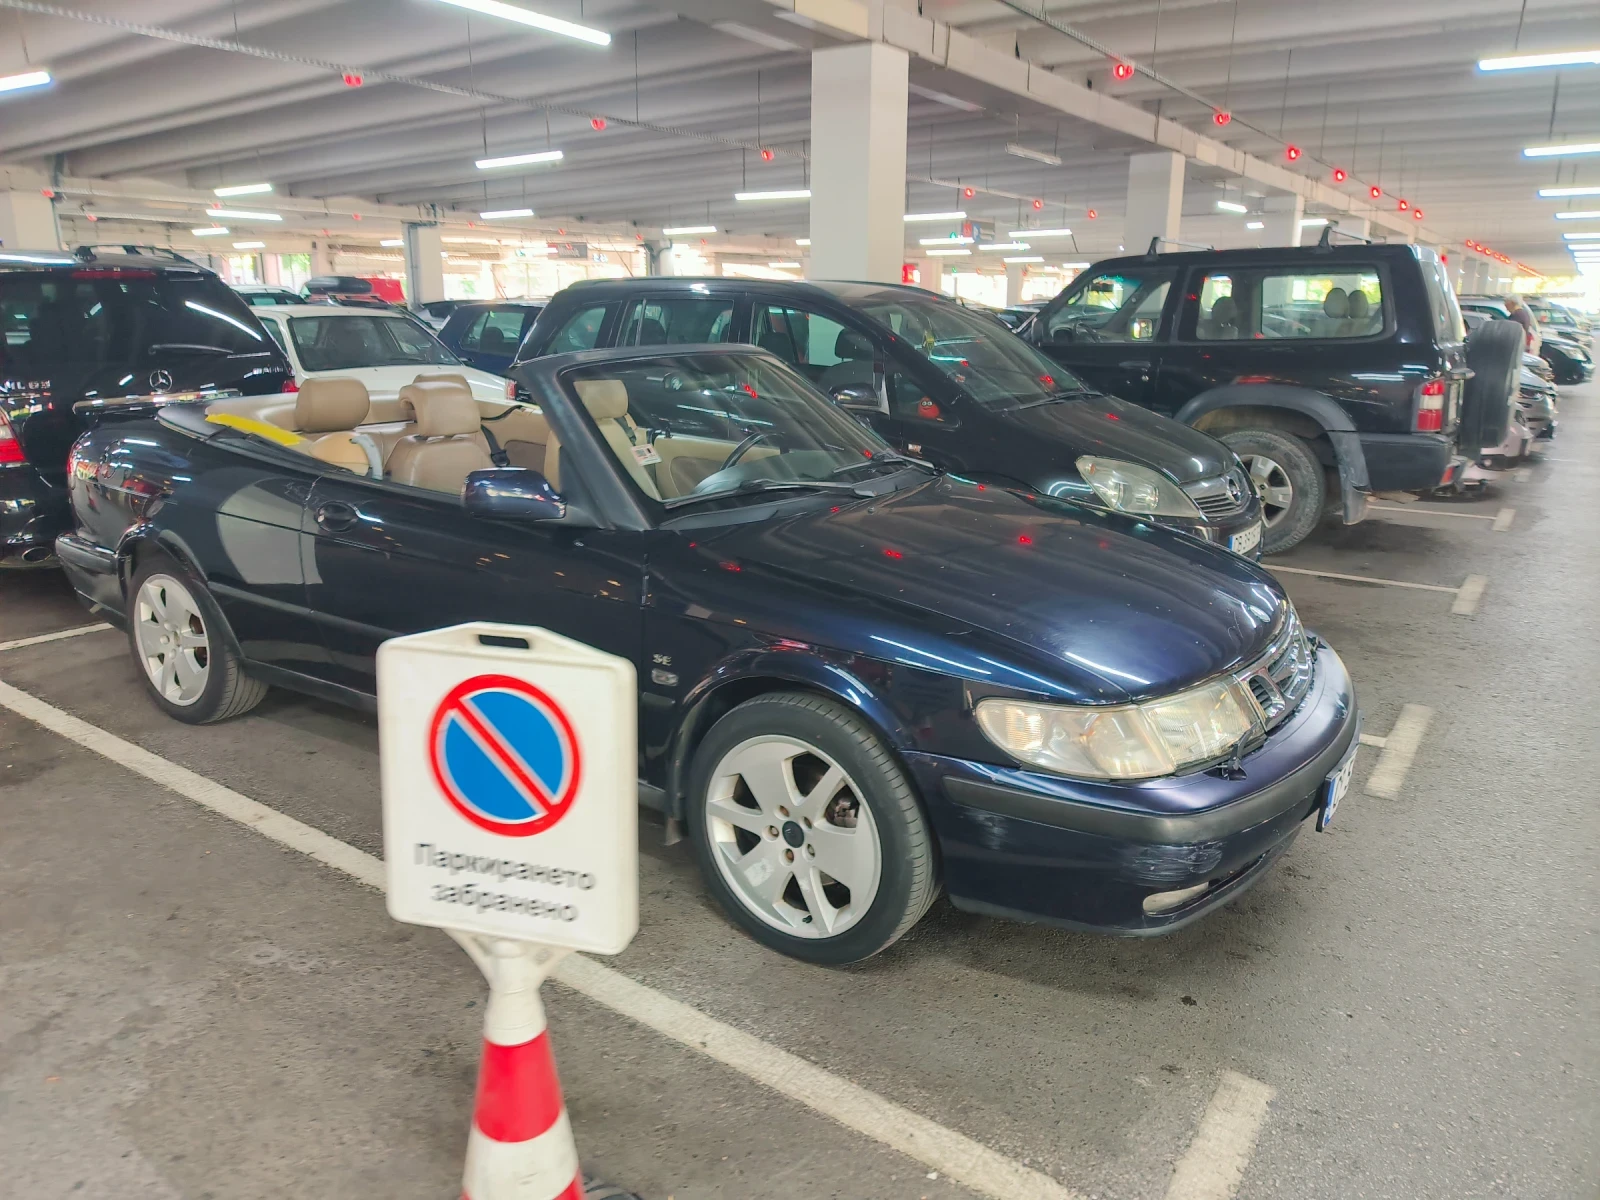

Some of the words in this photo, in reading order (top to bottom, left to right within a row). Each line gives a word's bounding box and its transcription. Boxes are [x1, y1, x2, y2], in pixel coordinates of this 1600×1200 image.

[652, 653, 672, 666] SE
[414, 843, 596, 891] Паркирането
[431, 882, 579, 922] забранено
